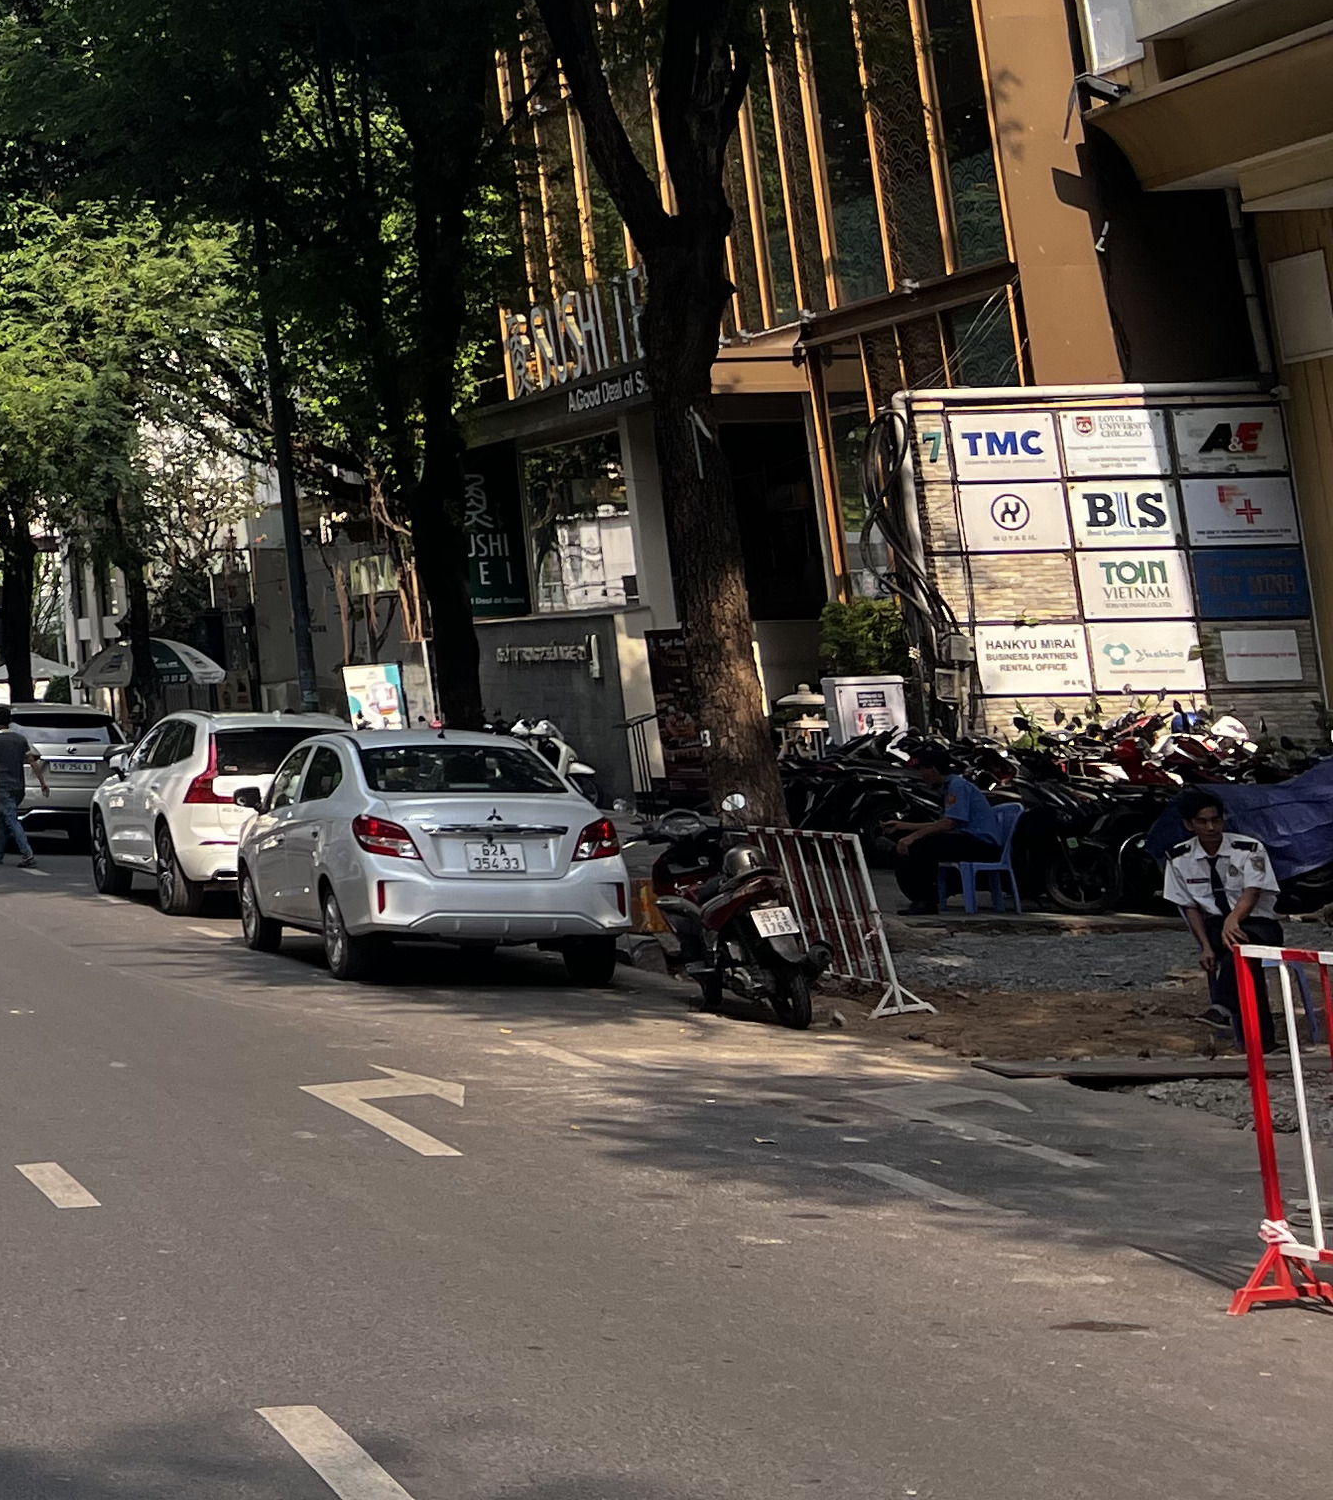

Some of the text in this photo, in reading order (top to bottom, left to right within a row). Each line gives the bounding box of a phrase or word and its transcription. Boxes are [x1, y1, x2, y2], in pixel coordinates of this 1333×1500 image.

[530, 283, 610, 391] SUSHI
[568, 391, 576, 412] A
[576, 382, 600, 411] Good
[602, 377, 623, 403] Deal
[623, 377, 633, 396] of
[922, 432, 942, 463] 7
[961, 430, 1044, 456] TMC
[1199, 422, 1263, 453] A&E
[468, 533, 510, 557] USHI
[1099, 560, 1168, 584] TOIN
[1102, 586, 1171, 600] VIETNAM
[986, 639, 1076, 649] HANKYU MIRAI
[986, 652, 1079, 661] BUSINESS PARTNERS
[999, 663, 1068, 672] RENTAL OFFICE
[482, 844, 507, 857] 62A
